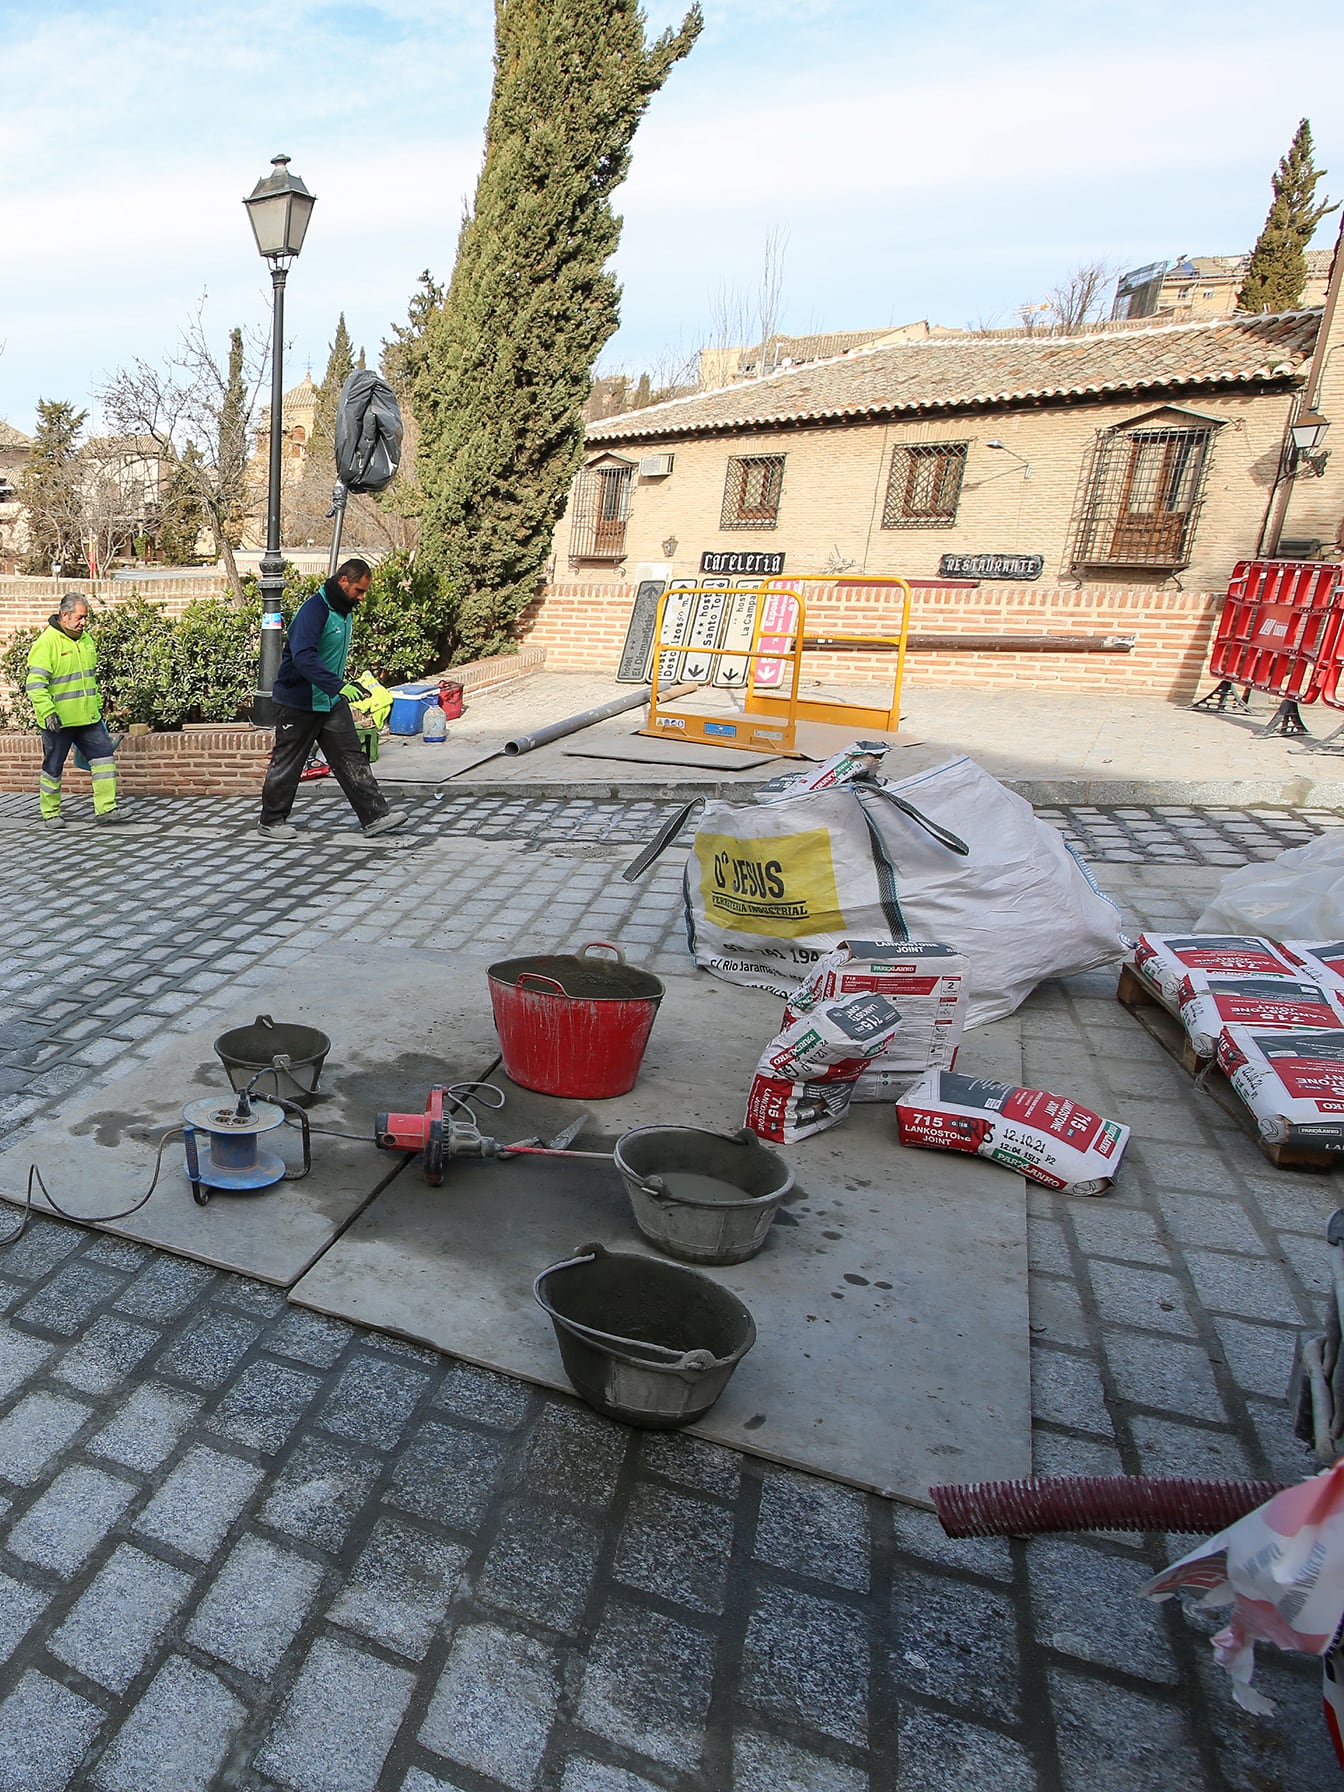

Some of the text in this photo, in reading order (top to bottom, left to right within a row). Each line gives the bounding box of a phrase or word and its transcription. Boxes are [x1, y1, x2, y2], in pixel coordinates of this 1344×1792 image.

[946, 557, 1035, 574] RESTAURANTE
[699, 582, 715, 618] hostl
[736, 585, 749, 613] hostl
[743, 584, 759, 626] Campaa
[703, 614, 718, 646] Santo
[663, 622, 684, 677] Desclzos
[732, 859, 785, 899] JESUS
[748, 904, 808, 916] INDUSTRIAL
[896, 946, 924, 954] JOINT
[947, 982, 955, 990] 2
[1219, 1035, 1230, 1052] 715
[768, 1096, 783, 1118] 715
[913, 1113, 944, 1127] 715
[1070, 1112, 1093, 1133] 715
[904, 1124, 972, 1142] LANKOSTONE
[922, 1135, 952, 1147] JOINT
[1003, 1127, 1047, 1154] 12.10.21
